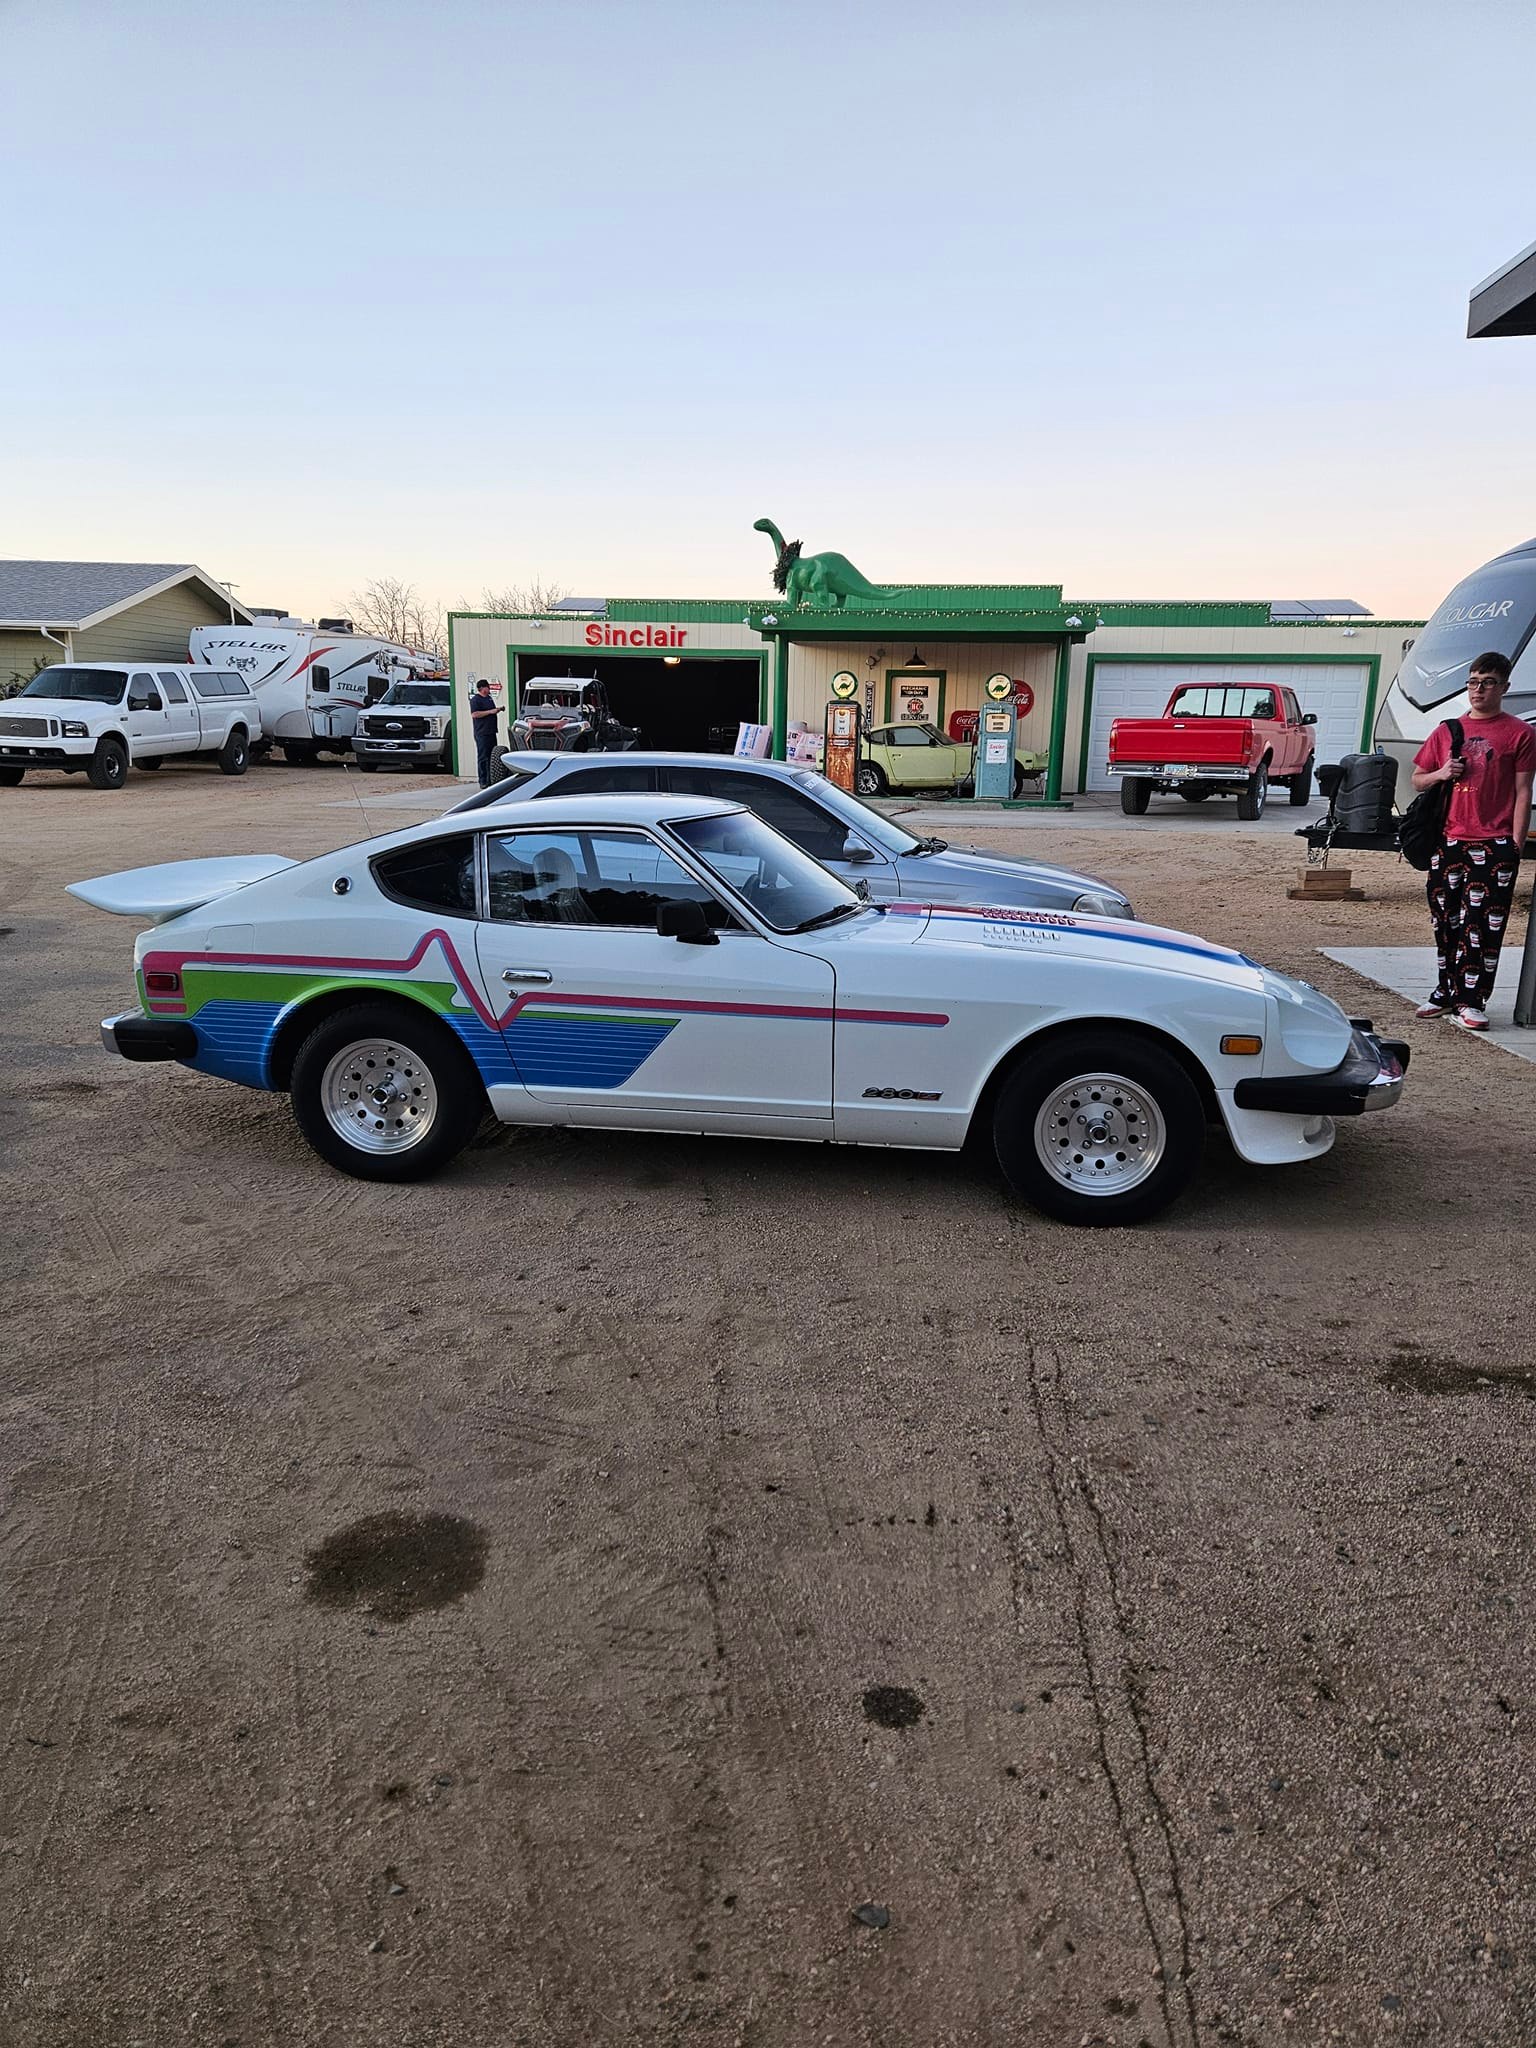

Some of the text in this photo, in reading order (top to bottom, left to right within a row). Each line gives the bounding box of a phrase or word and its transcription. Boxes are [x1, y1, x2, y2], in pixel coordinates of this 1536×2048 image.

[1438, 600, 1514, 626] COUGAR
[585, 623, 688, 647] Sinclair
[204, 640, 288, 653] STELLAR
[337, 682, 366, 694] STELLAR
